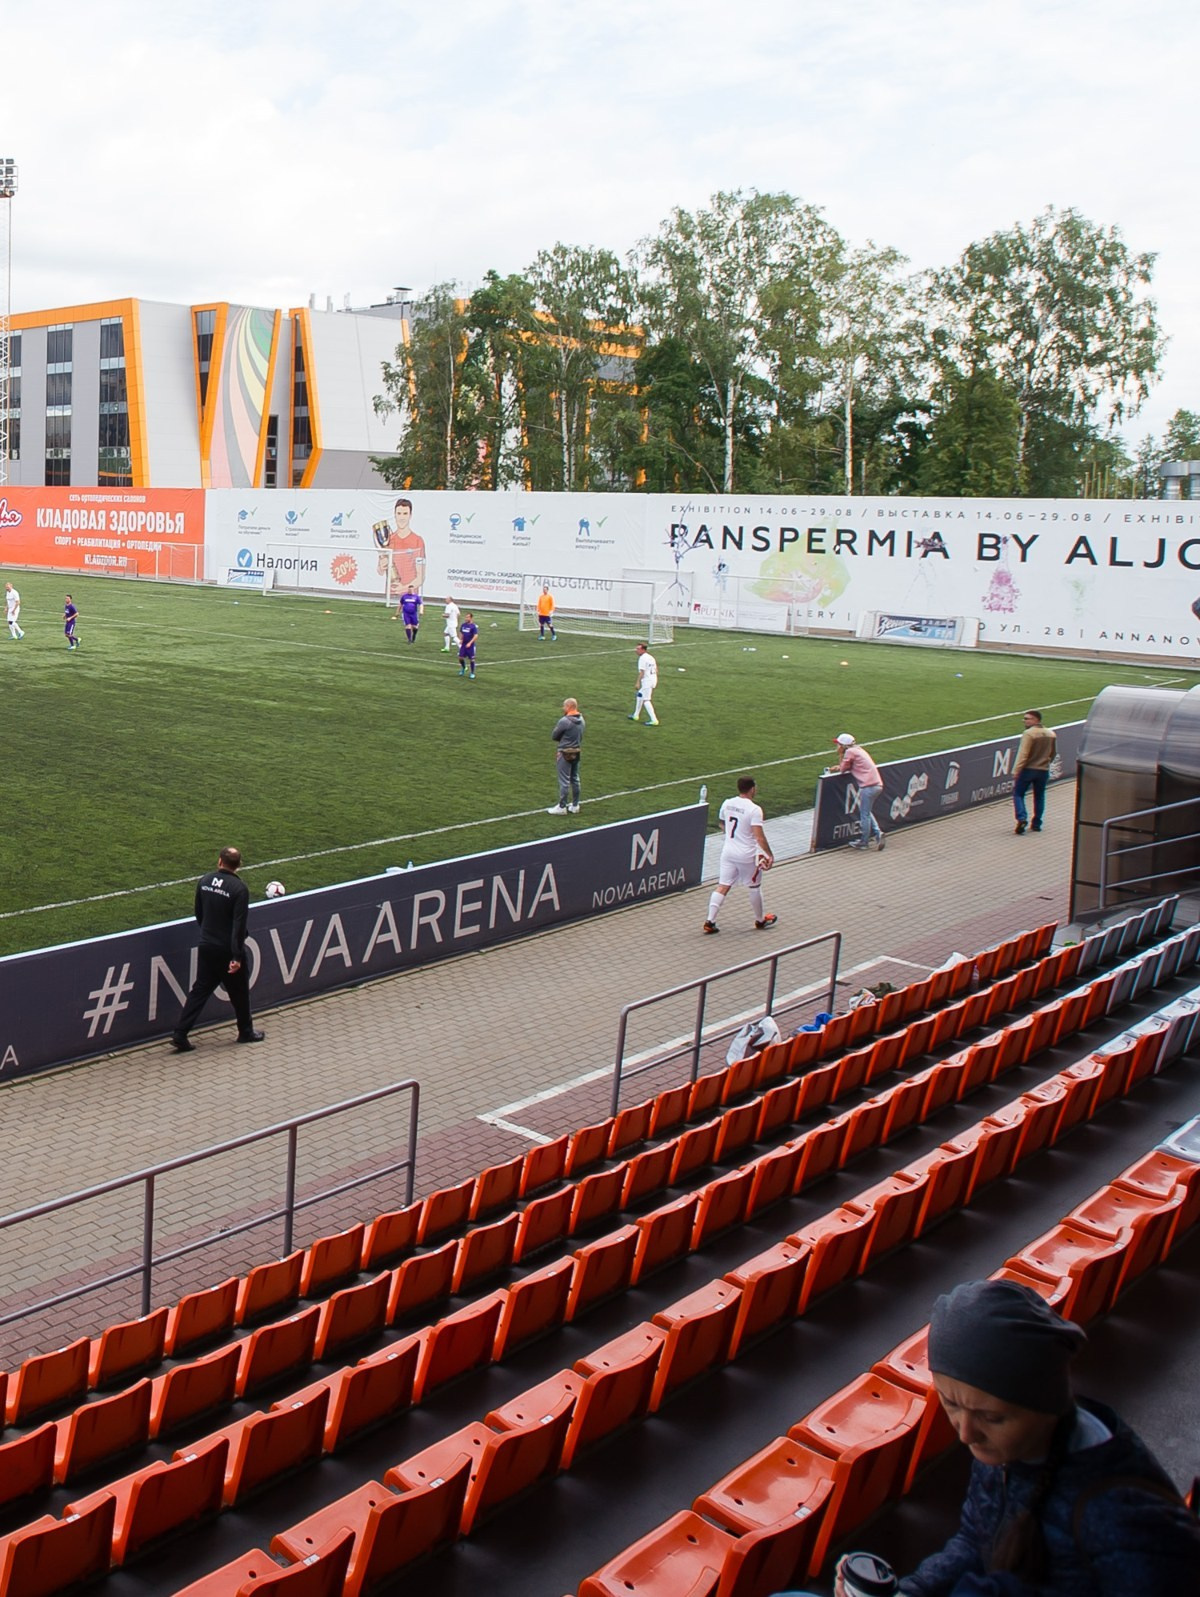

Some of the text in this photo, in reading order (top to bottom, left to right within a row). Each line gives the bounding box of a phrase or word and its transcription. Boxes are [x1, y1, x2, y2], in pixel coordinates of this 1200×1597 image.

[36, 508, 185, 535] КЛАДОВАЯ ЗДОРОВЬЯ
[671, 505, 751, 514] EXHIBITION
[877, 509, 966, 520] ВЫСТАВКА
[1124, 514, 1200, 524] EXHIBI
[55, 536, 72, 546] СПОРТ
[669, 522, 950, 560] PANSPERMIA
[976, 532, 1040, 563] BY
[256, 552, 318, 572] Налогия
[333, 559, 356, 579] 20%
[532, 575, 614, 592] NALOGIA.RU
[787, 608, 836, 618] LLERY
[1000, 623, 1030, 633] УЛ.
[1044, 626, 1065, 636] 28
[1099, 630, 1200, 646] ANNANO
[970, 786, 995, 803] NOVA
[996, 780, 1014, 797] ARE
[728, 815, 738, 839] 7
[832, 820, 863, 840] FITNE
[592, 867, 687, 909] NOVA ARENA
